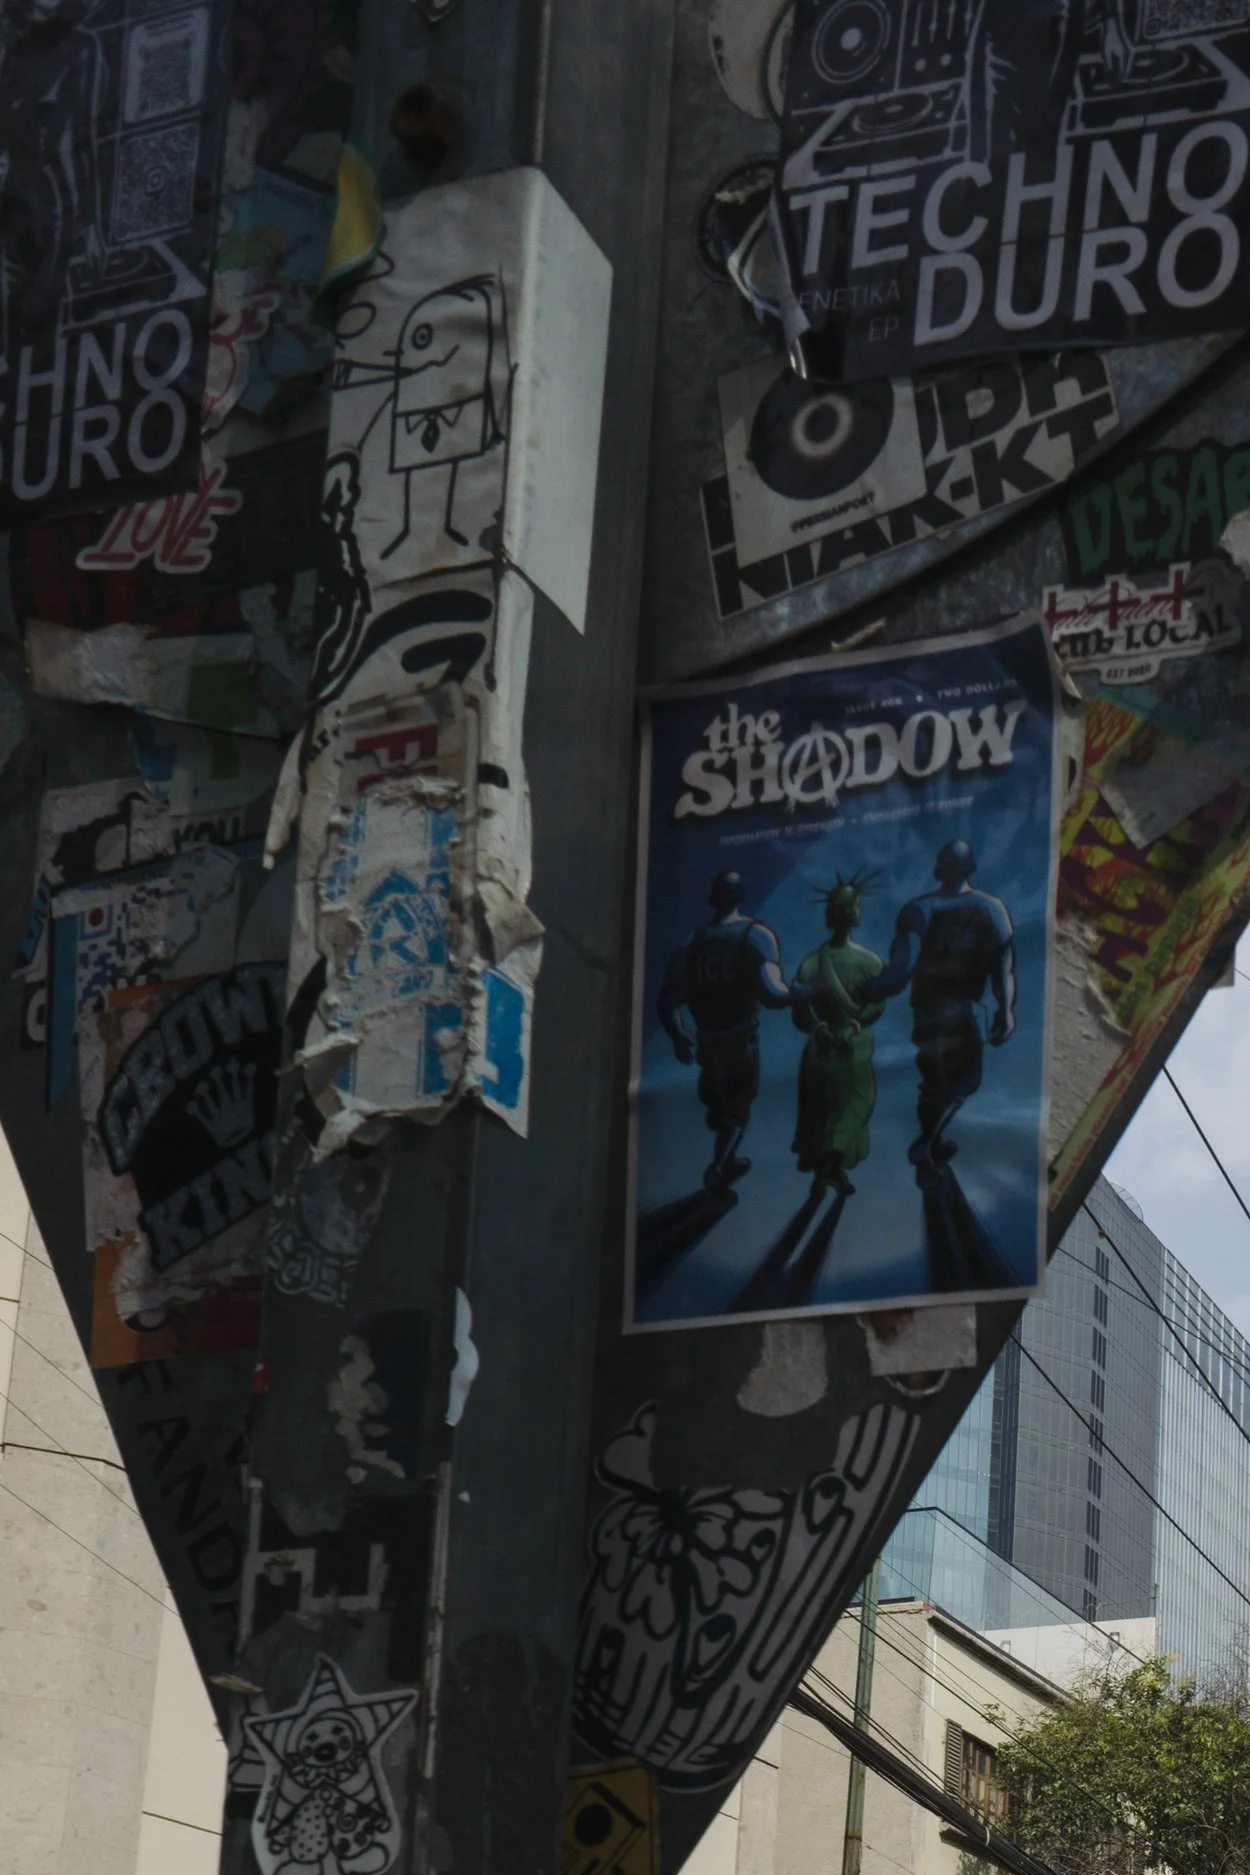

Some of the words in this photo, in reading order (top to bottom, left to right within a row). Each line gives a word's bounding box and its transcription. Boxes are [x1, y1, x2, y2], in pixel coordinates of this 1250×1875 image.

[788, 120, 1250, 276] TECHNO
[799, 278, 901, 314] ENETIKA
[913, 212, 1242, 347] DURO
[12, 308, 193, 423] HNO
[12, 387, 188, 501] URO
[673, 698, 1028, 820] SHADOW
[702, 701, 783, 750] the
